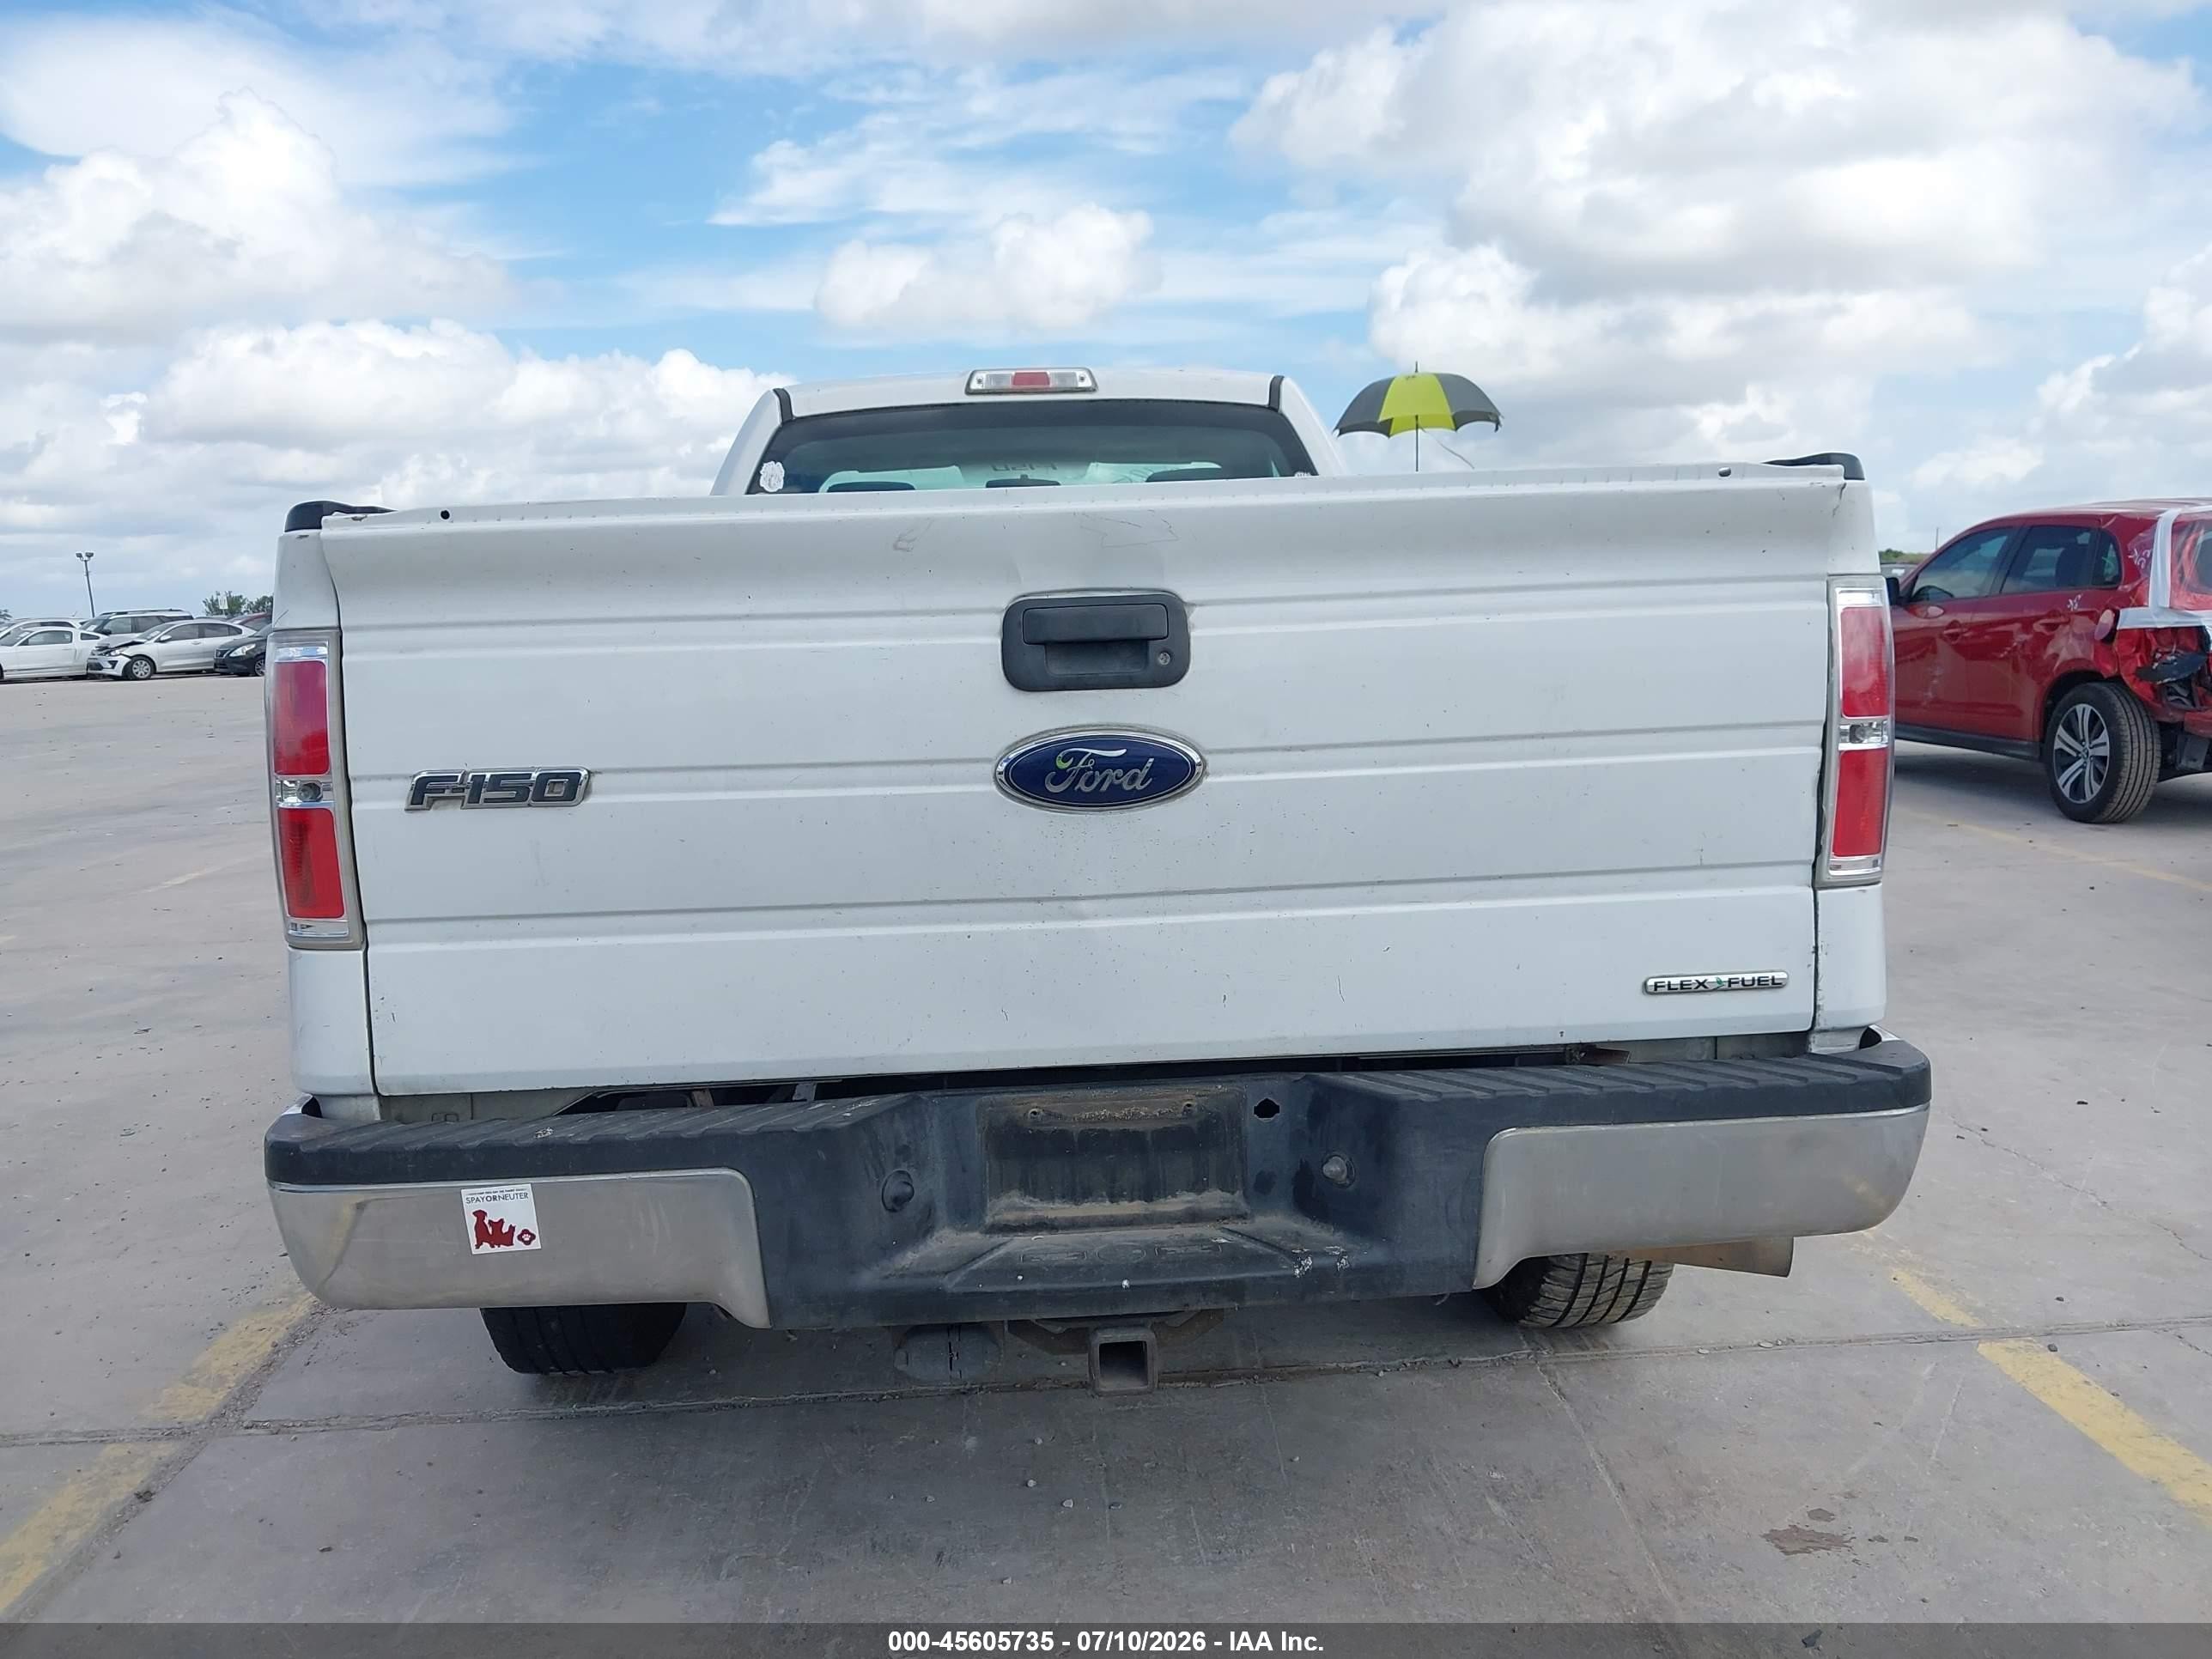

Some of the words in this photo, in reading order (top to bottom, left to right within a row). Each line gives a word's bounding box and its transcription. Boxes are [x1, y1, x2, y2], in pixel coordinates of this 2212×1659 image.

[405, 769, 589, 811] F-150
[1044, 748, 1155, 793] Ford
[1653, 979, 1710, 992] FLEX
[1727, 975, 1783, 988] FUEL
